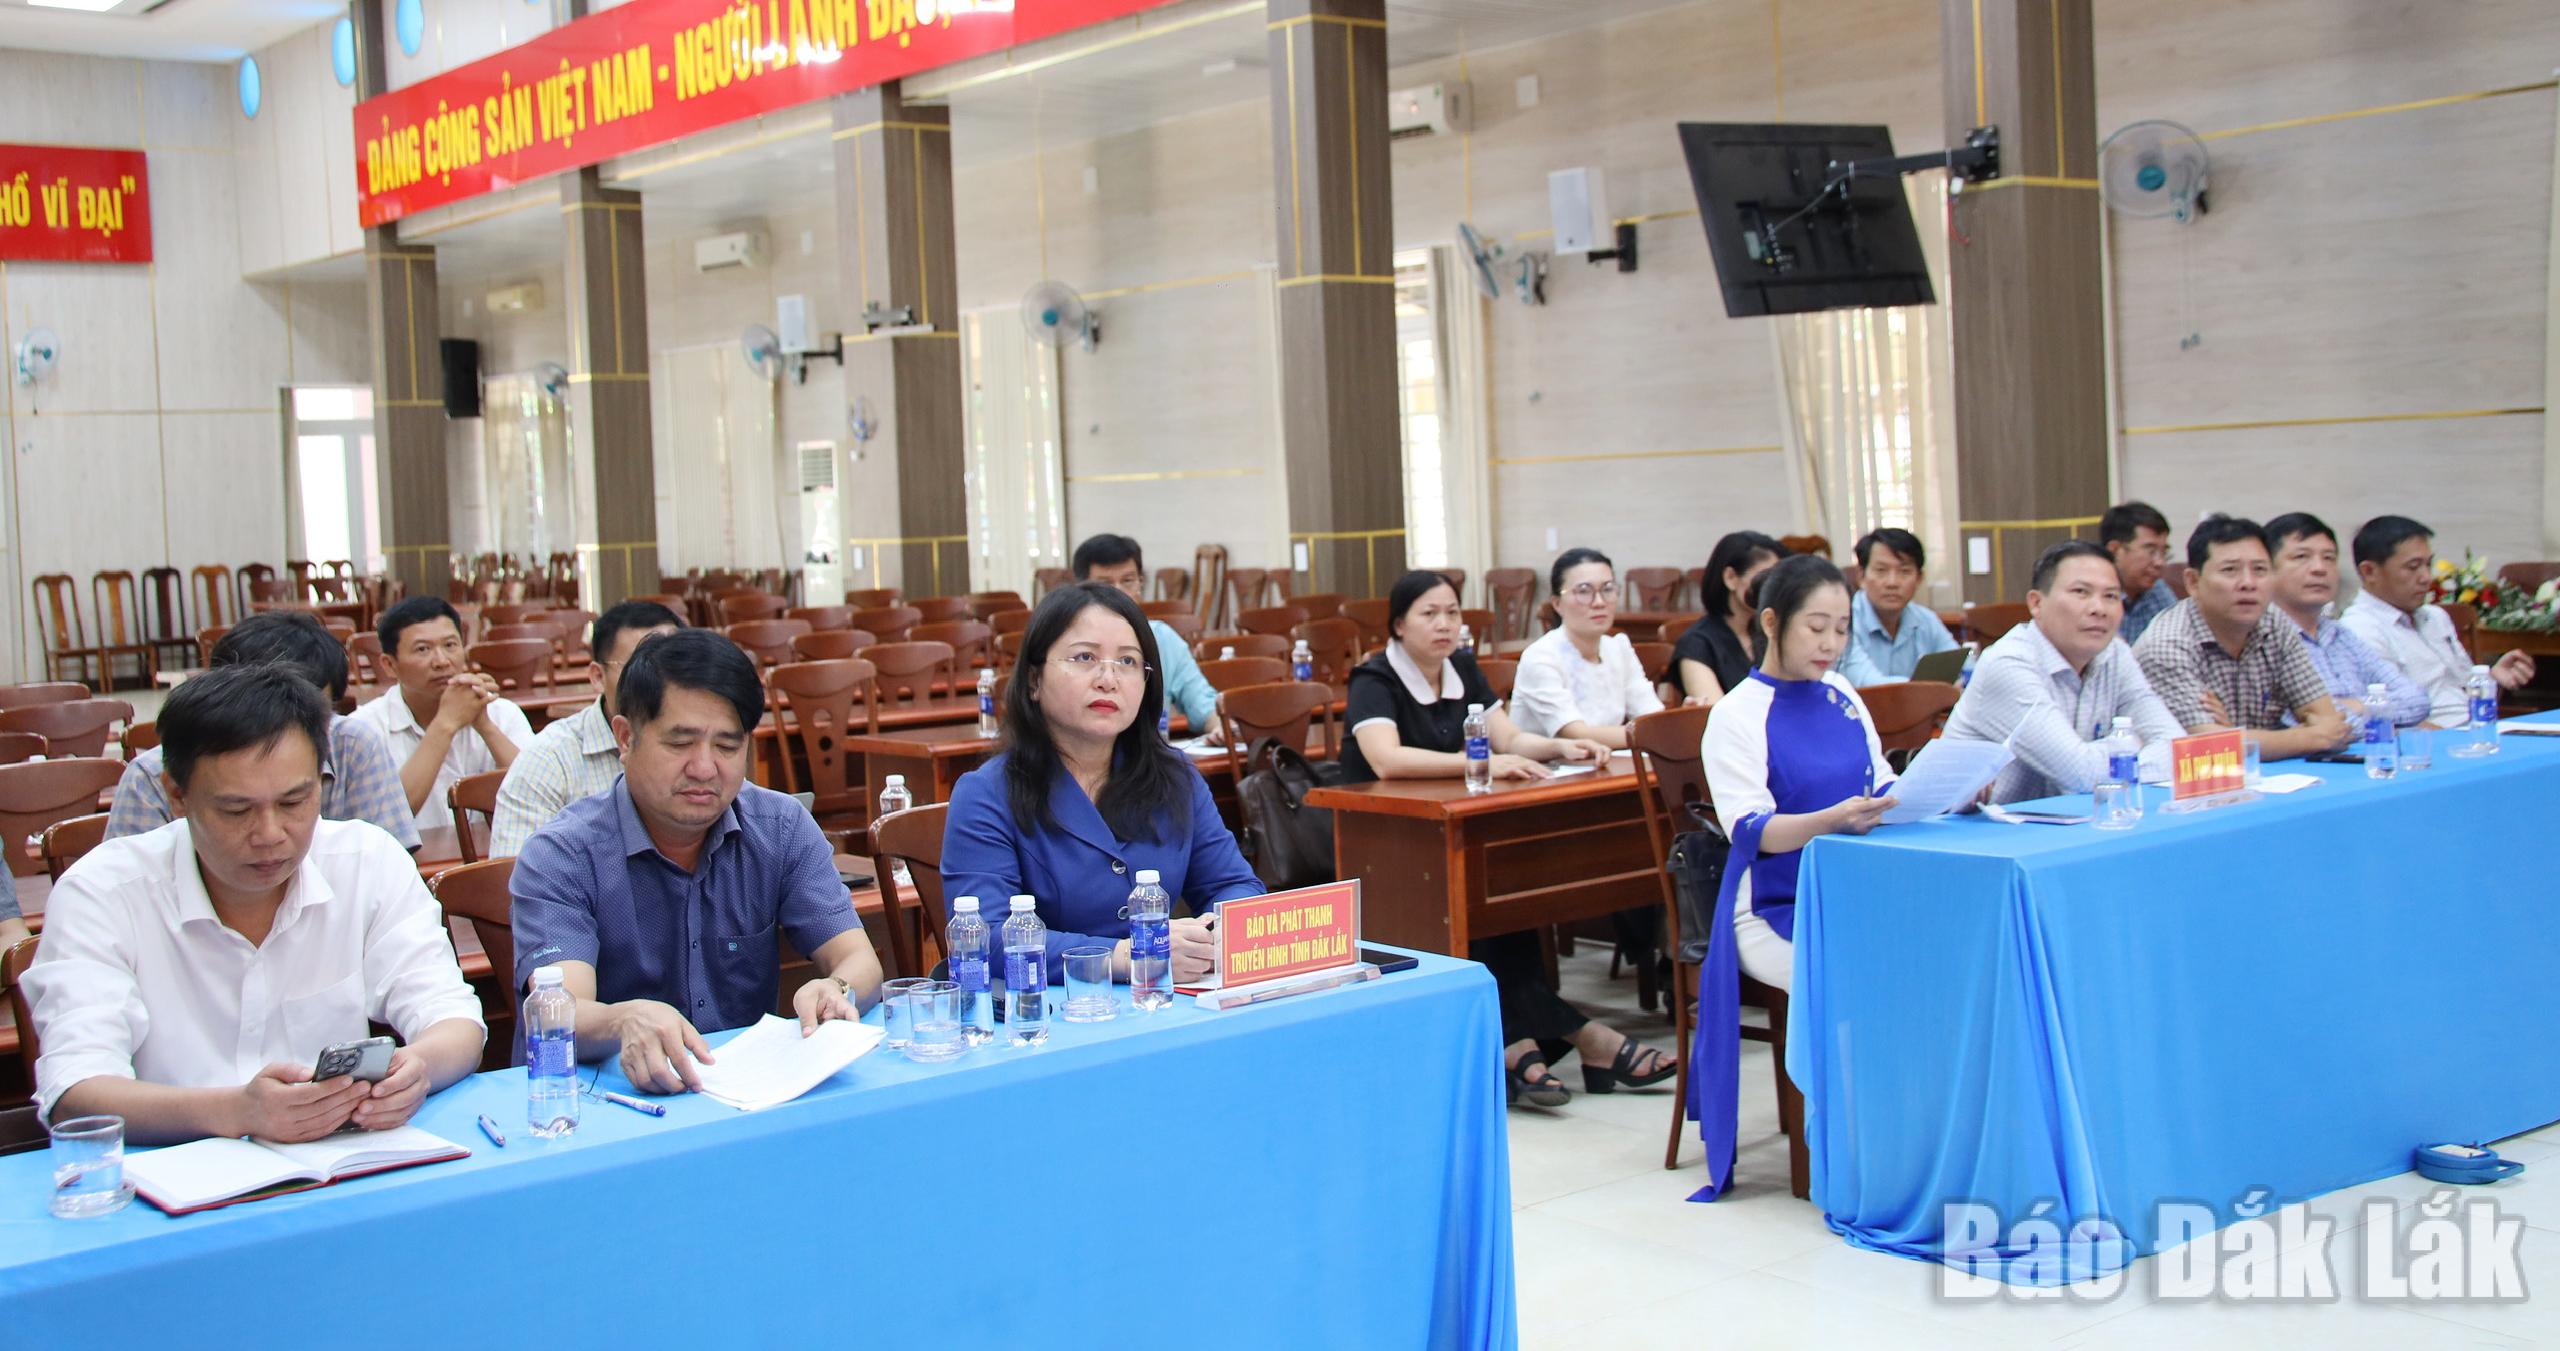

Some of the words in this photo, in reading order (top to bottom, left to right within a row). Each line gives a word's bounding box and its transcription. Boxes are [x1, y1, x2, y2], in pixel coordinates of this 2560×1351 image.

[367, 115, 421, 195] ĐẢNG
[424, 100, 482, 187] CỘNG
[484, 70, 534, 158] SẢN
[536, 57, 586, 148] VIỆT
[592, 43, 653, 125] NAM
[674, 0, 764, 101] NGƯỜI
[41, 176, 70, 229] VĨ
[1246, 912, 1265, 939] BÁO
[1266, 909, 1278, 934] VÀ
[1280, 905, 1303, 932] PHÁT
[1304, 904, 1333, 928] THANH
[1231, 942, 1265, 975] TRUYỀN
[1267, 941, 1288, 968] HÌNH
[1290, 935, 1310, 965] TỈNH
[1312, 930, 1330, 960] ĐẮK
[1331, 927, 1348, 957] LẮK
